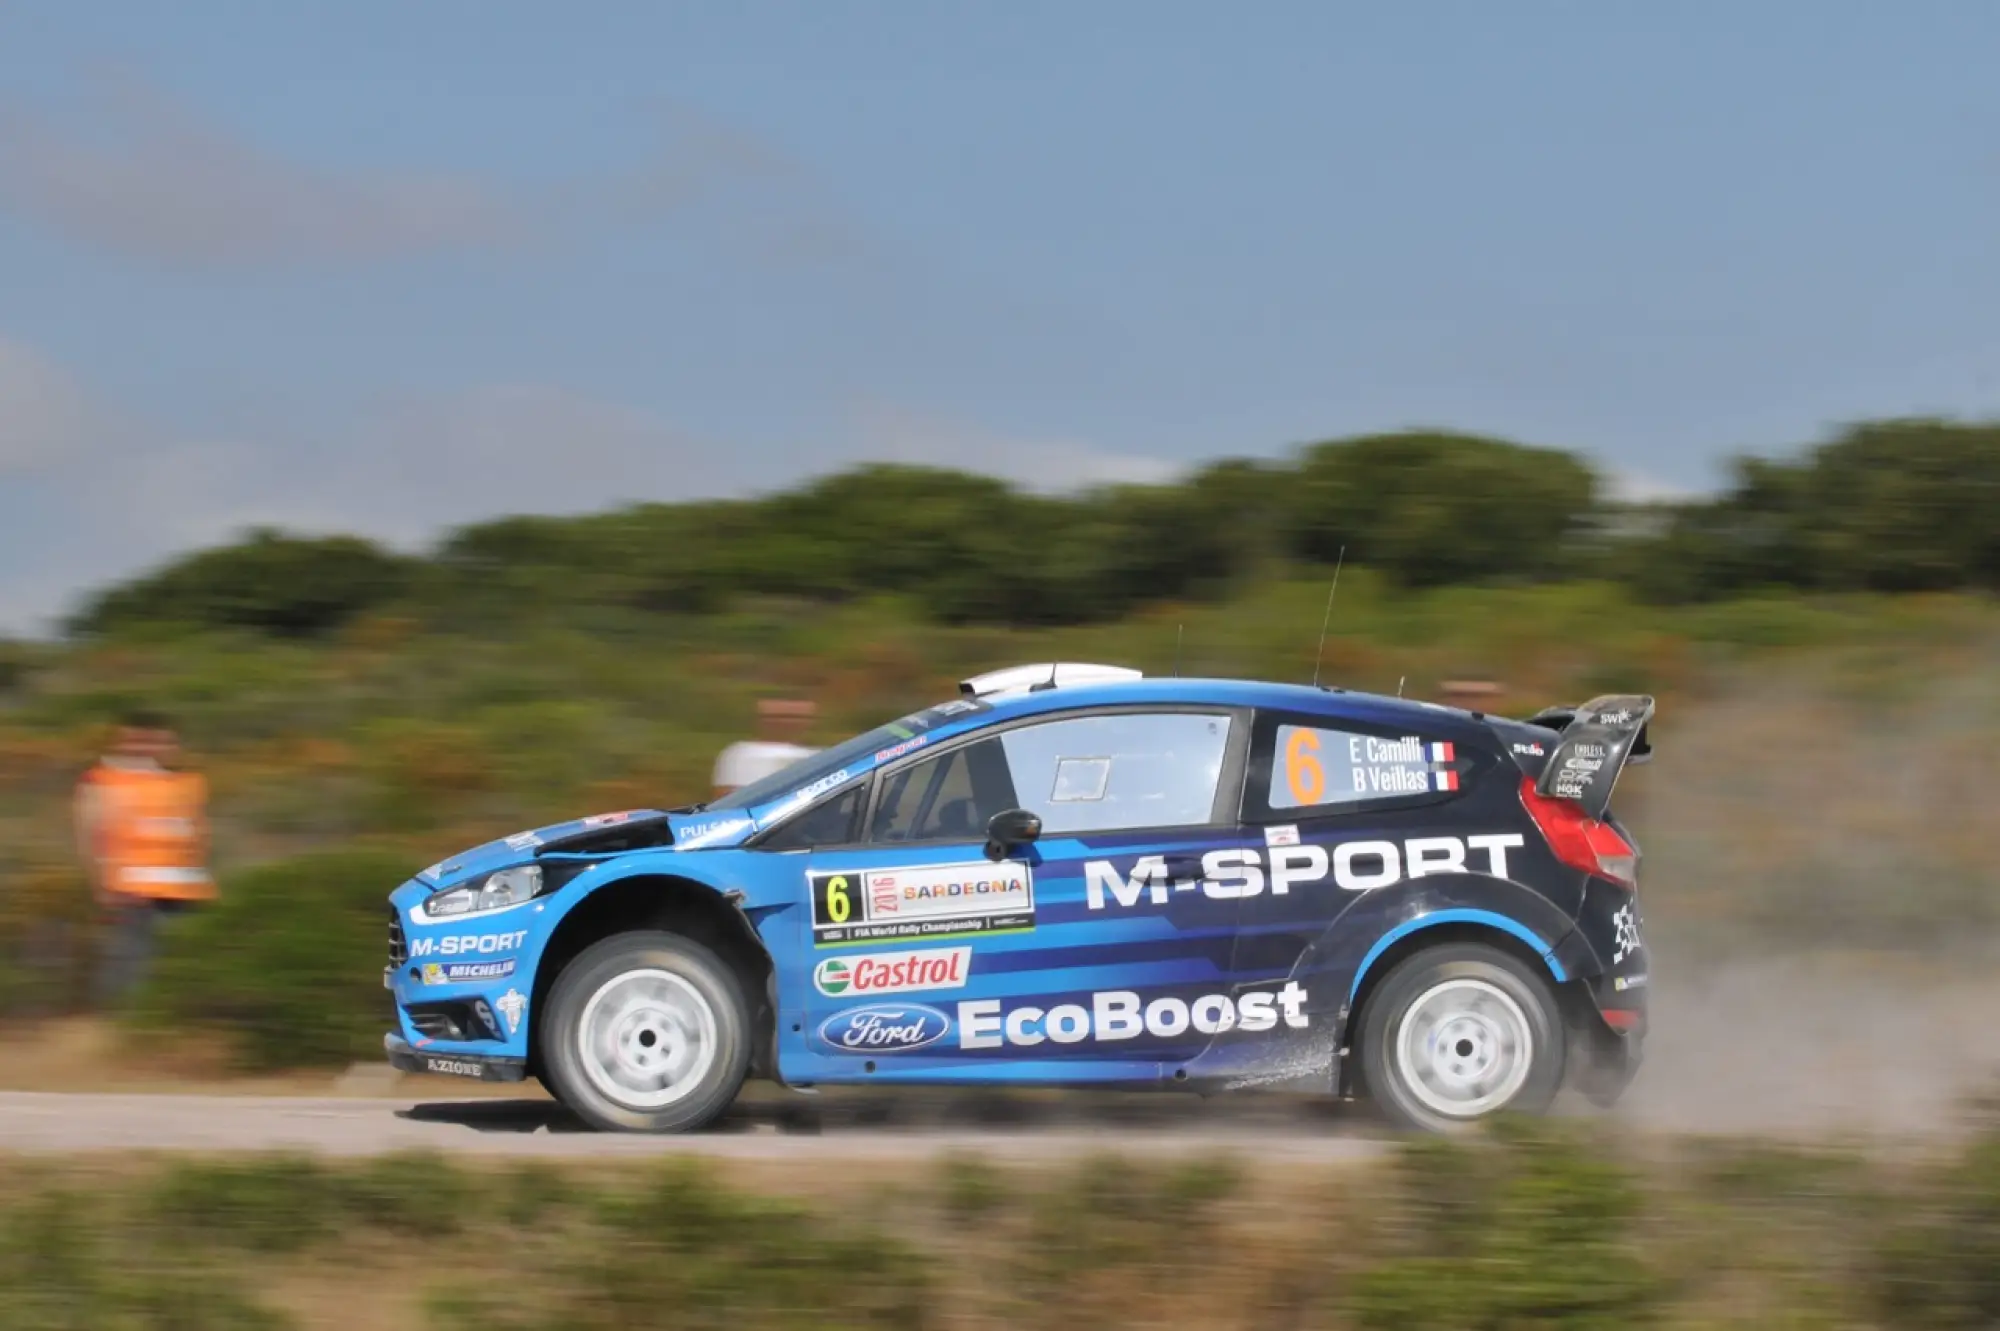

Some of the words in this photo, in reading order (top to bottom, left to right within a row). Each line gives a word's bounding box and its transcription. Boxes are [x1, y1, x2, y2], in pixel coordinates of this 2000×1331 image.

[1350, 739, 1361, 762] E
[1366, 736, 1421, 762] Camilli
[1286, 727, 1326, 805] 6
[1353, 769, 1366, 792] B
[1369, 765, 1427, 792] Veillas
[1084, 834, 1524, 909] M-SPORT
[827, 875, 850, 923] 6
[873, 877, 898, 913] 2016
[903, 878, 1022, 899] SARDEGNA
[411, 930, 528, 957] M-SPORT
[872, 925, 898, 937] World
[899, 924, 920, 936] Rally
[922, 919, 982, 933] Championship
[450, 959, 516, 977] MICHELIN
[853, 957, 959, 990] Castrol
[842, 1011, 925, 1047] Ford
[957, 981, 1308, 1050] EcoBoost
